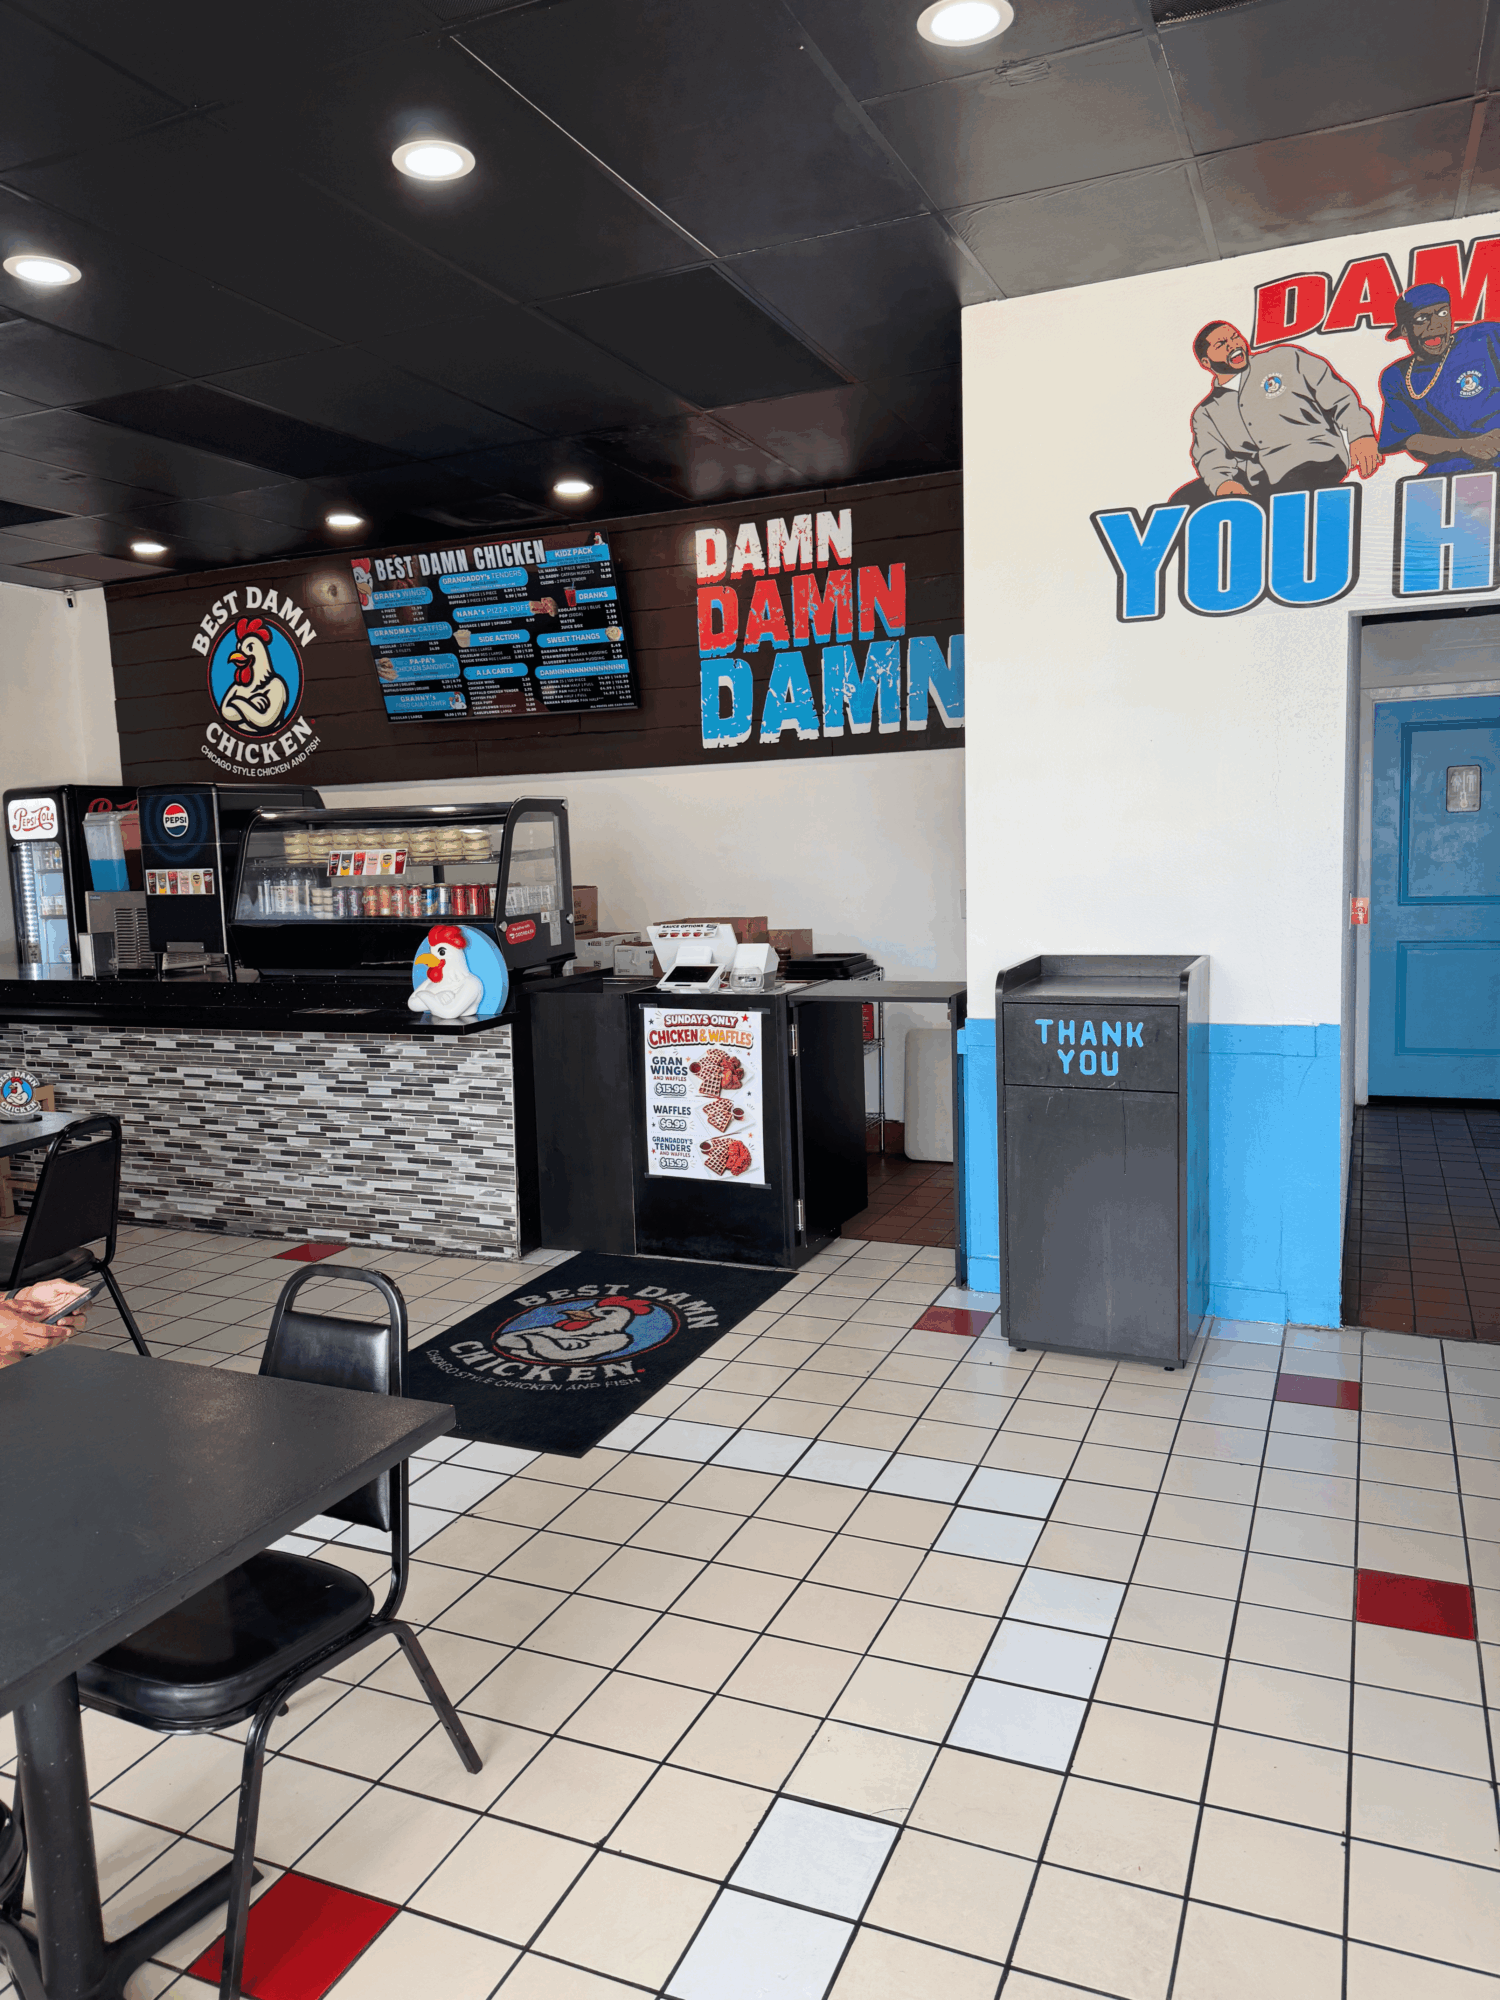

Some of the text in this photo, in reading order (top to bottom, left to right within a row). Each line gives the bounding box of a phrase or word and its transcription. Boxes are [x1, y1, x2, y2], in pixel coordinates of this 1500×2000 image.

[571, 547, 593, 555] PACK
[695, 508, 852, 584] DAMN
[1090, 482, 1362, 622] YOU
[374, 540, 546, 582] BEST DAMN CHICKEN
[490, 569, 522, 579] TENDERS
[373, 591, 400, 600] GRAN's
[578, 591, 608, 600] DRANKS
[455, 608, 485, 617] NANA's
[486, 606, 508, 614] PIZZA
[509, 604, 529, 612] PUFF
[697, 562, 906, 658] DAMN
[192, 586, 317, 656] BEST DAMN
[494, 633, 520, 641] ACTION
[546, 632, 600, 643] SWEET THANGS
[700, 633, 965, 749] DAMN
[206, 716, 313, 764] CHICKEN
[200, 736, 322, 777] CHICAGO STYLE CHICKEN AND FISH
[664, 1014, 738, 1028] SUNDAYS ONLY
[649, 1029, 752, 1046] CHICKEN & WAFFLES
[1035, 1019, 1144, 1047] THANK
[652, 1056, 683, 1066] GRAN
[1057, 1049, 1119, 1076] YOU
[650, 1066, 688, 1076] WINGS
[14, 1071, 38, 1087] DAMN
[655, 1084, 686, 1095] $15.99
[1, 1100, 37, 1113] CHICKEN
[653, 1105, 691, 1116] WAFFLES
[660, 1118, 687, 1130] $6.99
[655, 1143, 691, 1152] TENDERS
[660, 1157, 688, 1169] $15.99
[514, 1284, 719, 1329] BEST DAMN
[450, 1340, 635, 1382] CHICKEN
[494, 1378, 563, 1391] CHICKEN
